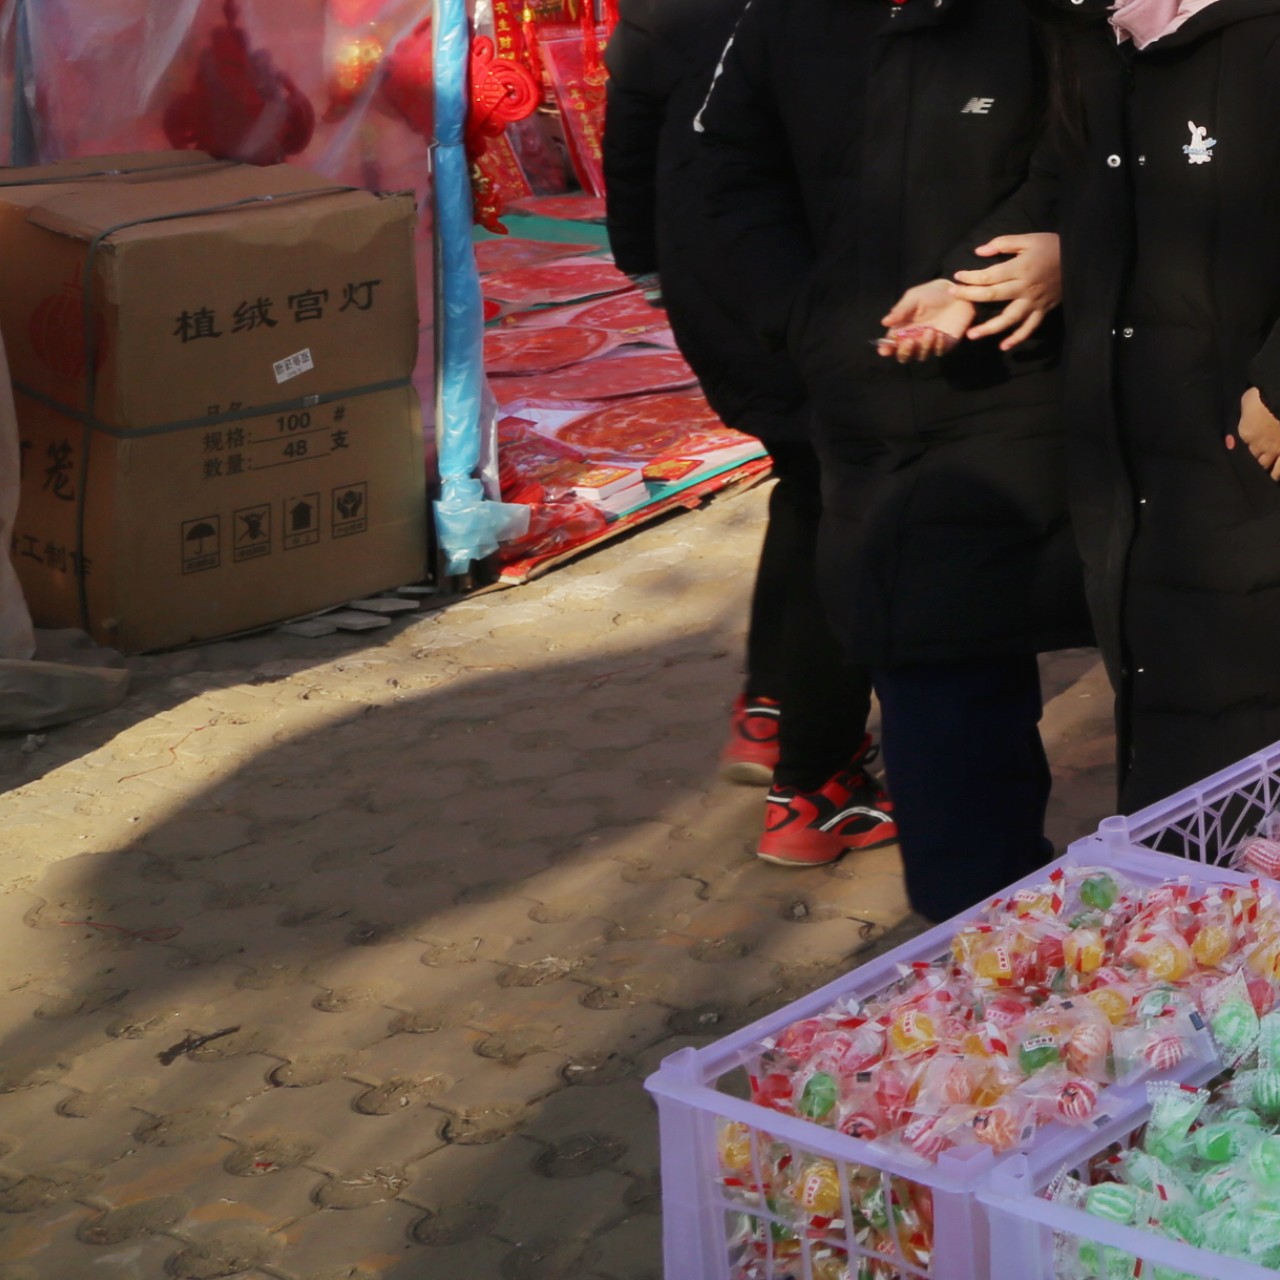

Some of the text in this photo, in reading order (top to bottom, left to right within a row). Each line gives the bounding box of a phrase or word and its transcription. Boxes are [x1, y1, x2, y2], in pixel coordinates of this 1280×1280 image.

[173, 278, 382, 344] 植绒宫灯
[277, 412, 312, 434] 100
[333, 405, 346, 423] #
[282, 439, 308, 459] 48
[330, 430, 350, 452] 支
